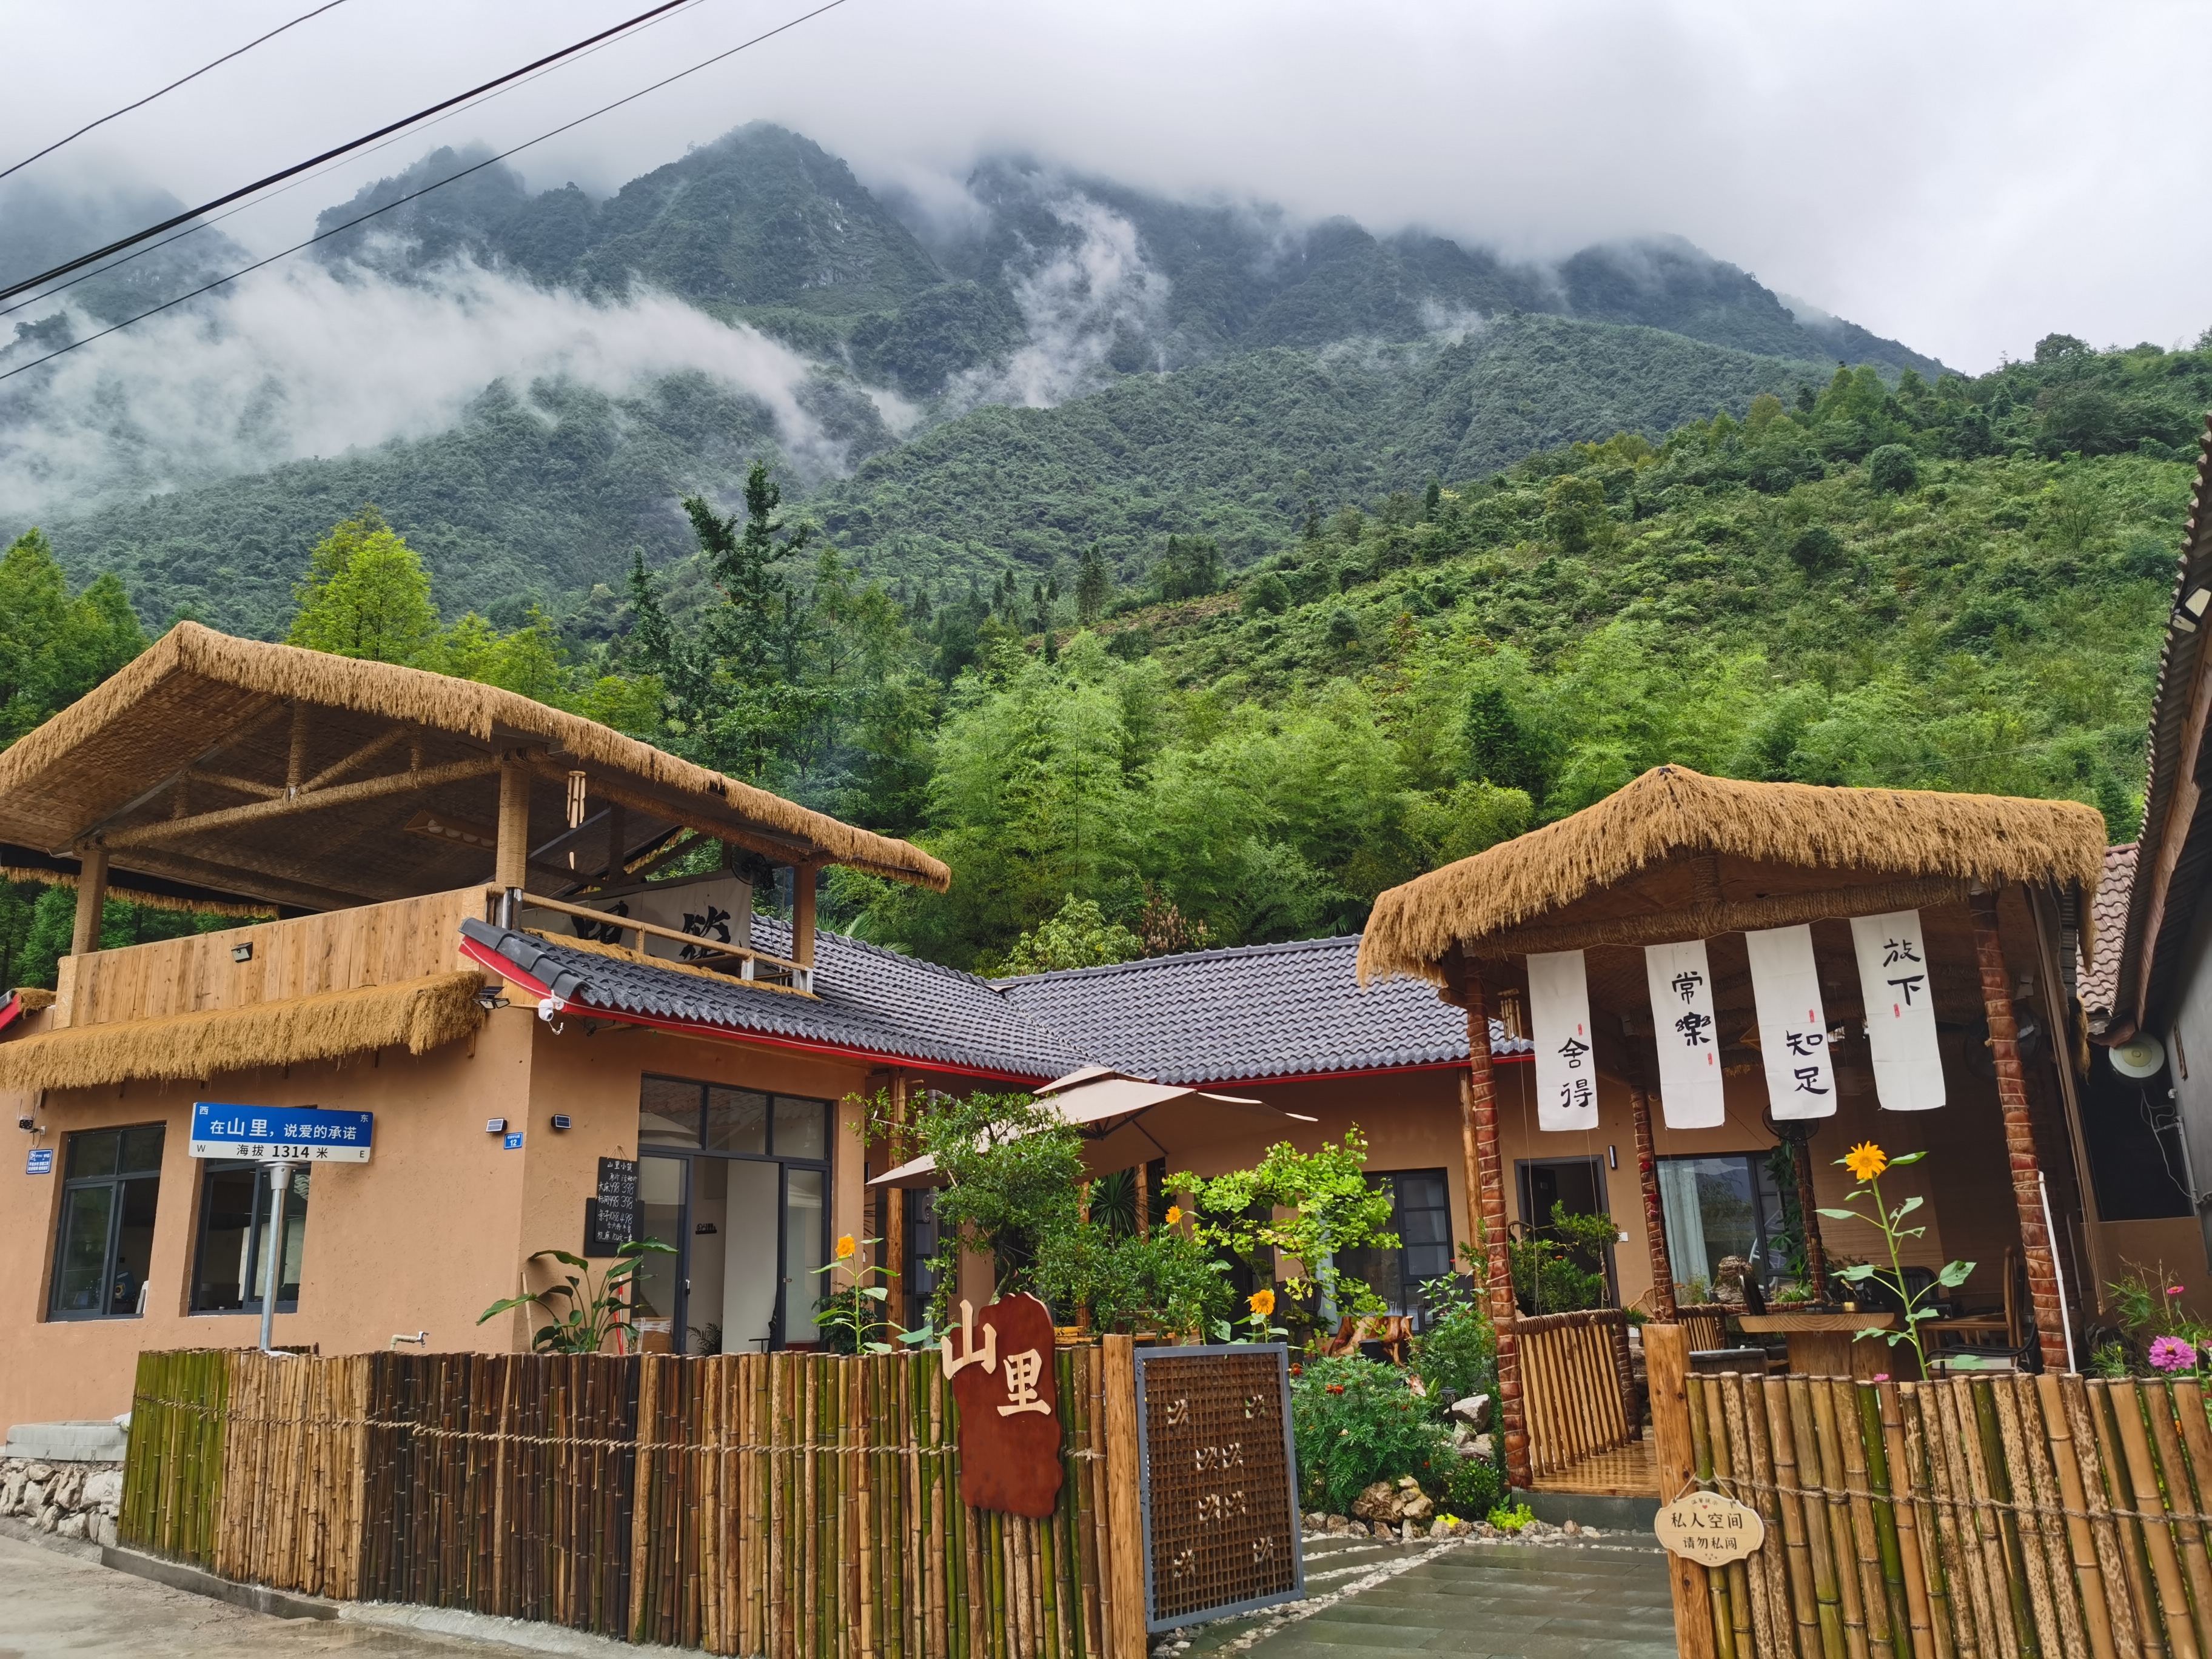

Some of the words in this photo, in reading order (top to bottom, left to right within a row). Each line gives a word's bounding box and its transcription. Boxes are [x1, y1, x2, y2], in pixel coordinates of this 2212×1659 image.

[1883, 938, 1925, 1007] 放下
[1787, 1030, 1830, 1095] 知足
[1558, 1037, 1594, 1108] 舍得
[199, 1106, 209, 1115] 西
[360, 1114, 369, 1123] 东
[236, 1144, 264, 1157] 海拔
[272, 1145, 310, 1158] 1314
[316, 1147, 328, 1159] 米
[622, 1182, 634, 1195] 398
[620, 1196, 633, 1209] 398
[940, 1299, 1051, 1416] 山里
[1671, 1512, 1743, 1529] 私人空间
[1683, 1537, 1737, 1550] 请勿私闯
